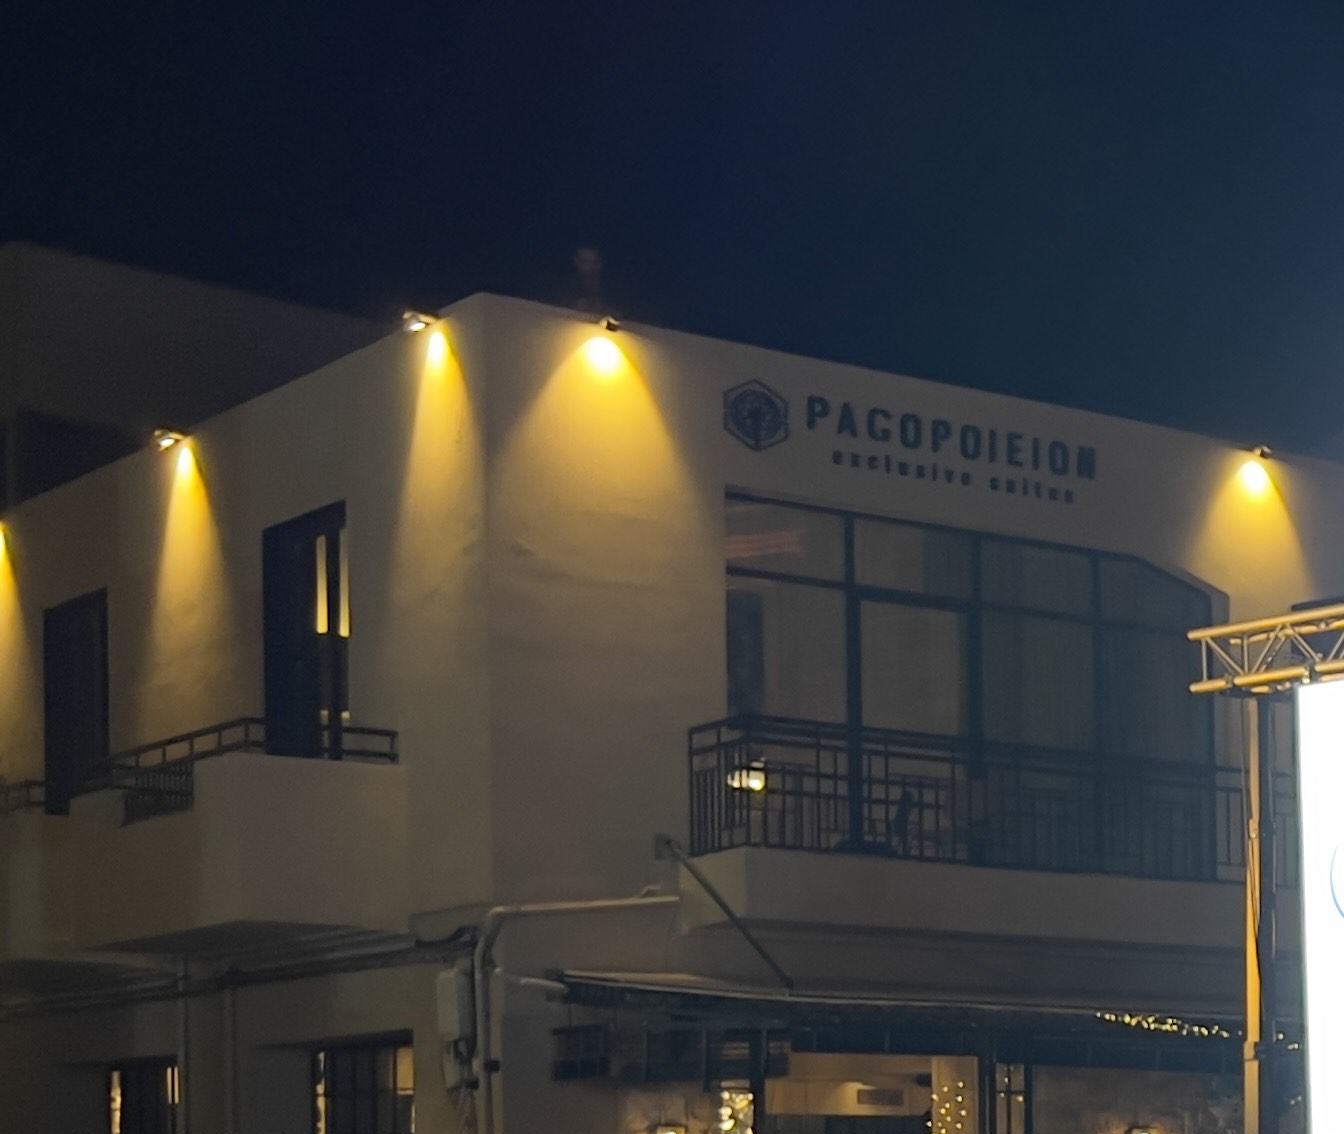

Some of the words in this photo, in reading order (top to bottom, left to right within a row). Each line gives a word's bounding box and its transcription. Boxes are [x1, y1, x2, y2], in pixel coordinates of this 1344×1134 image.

[806, 395, 1096, 480] PAGOPOIEION
[832, 449, 971, 486] exclusive
[989, 476, 1074, 503] suites
